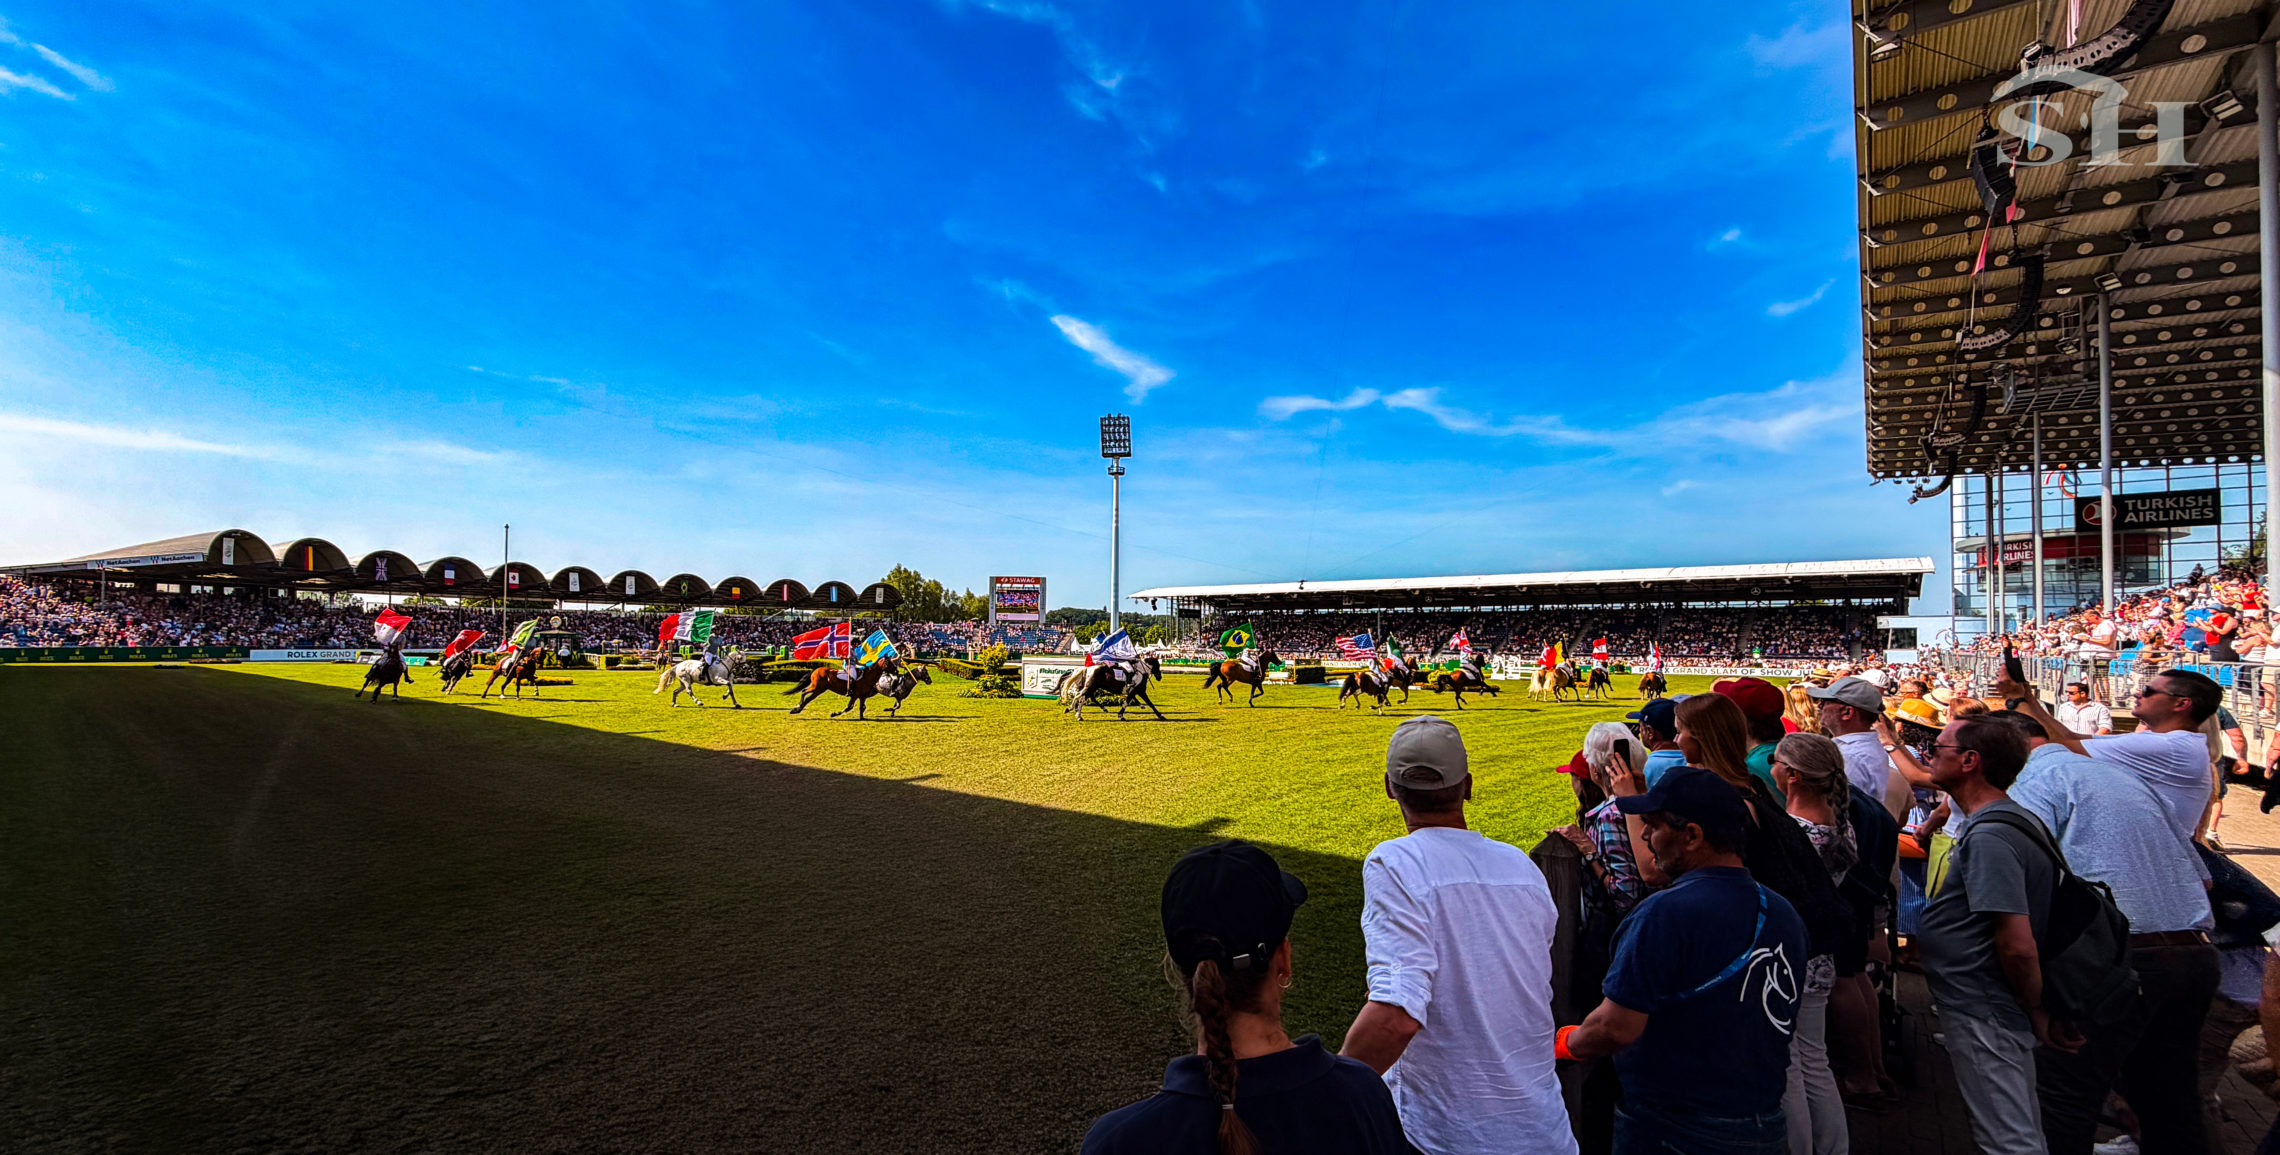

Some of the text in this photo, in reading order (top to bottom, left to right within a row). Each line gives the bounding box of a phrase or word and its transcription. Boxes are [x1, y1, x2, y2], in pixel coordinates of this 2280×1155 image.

[2124, 495, 2213, 511] TURKISH
[2124, 508, 2215, 523] AIRLINES
[1760, 668, 1793, 676] SHOW
